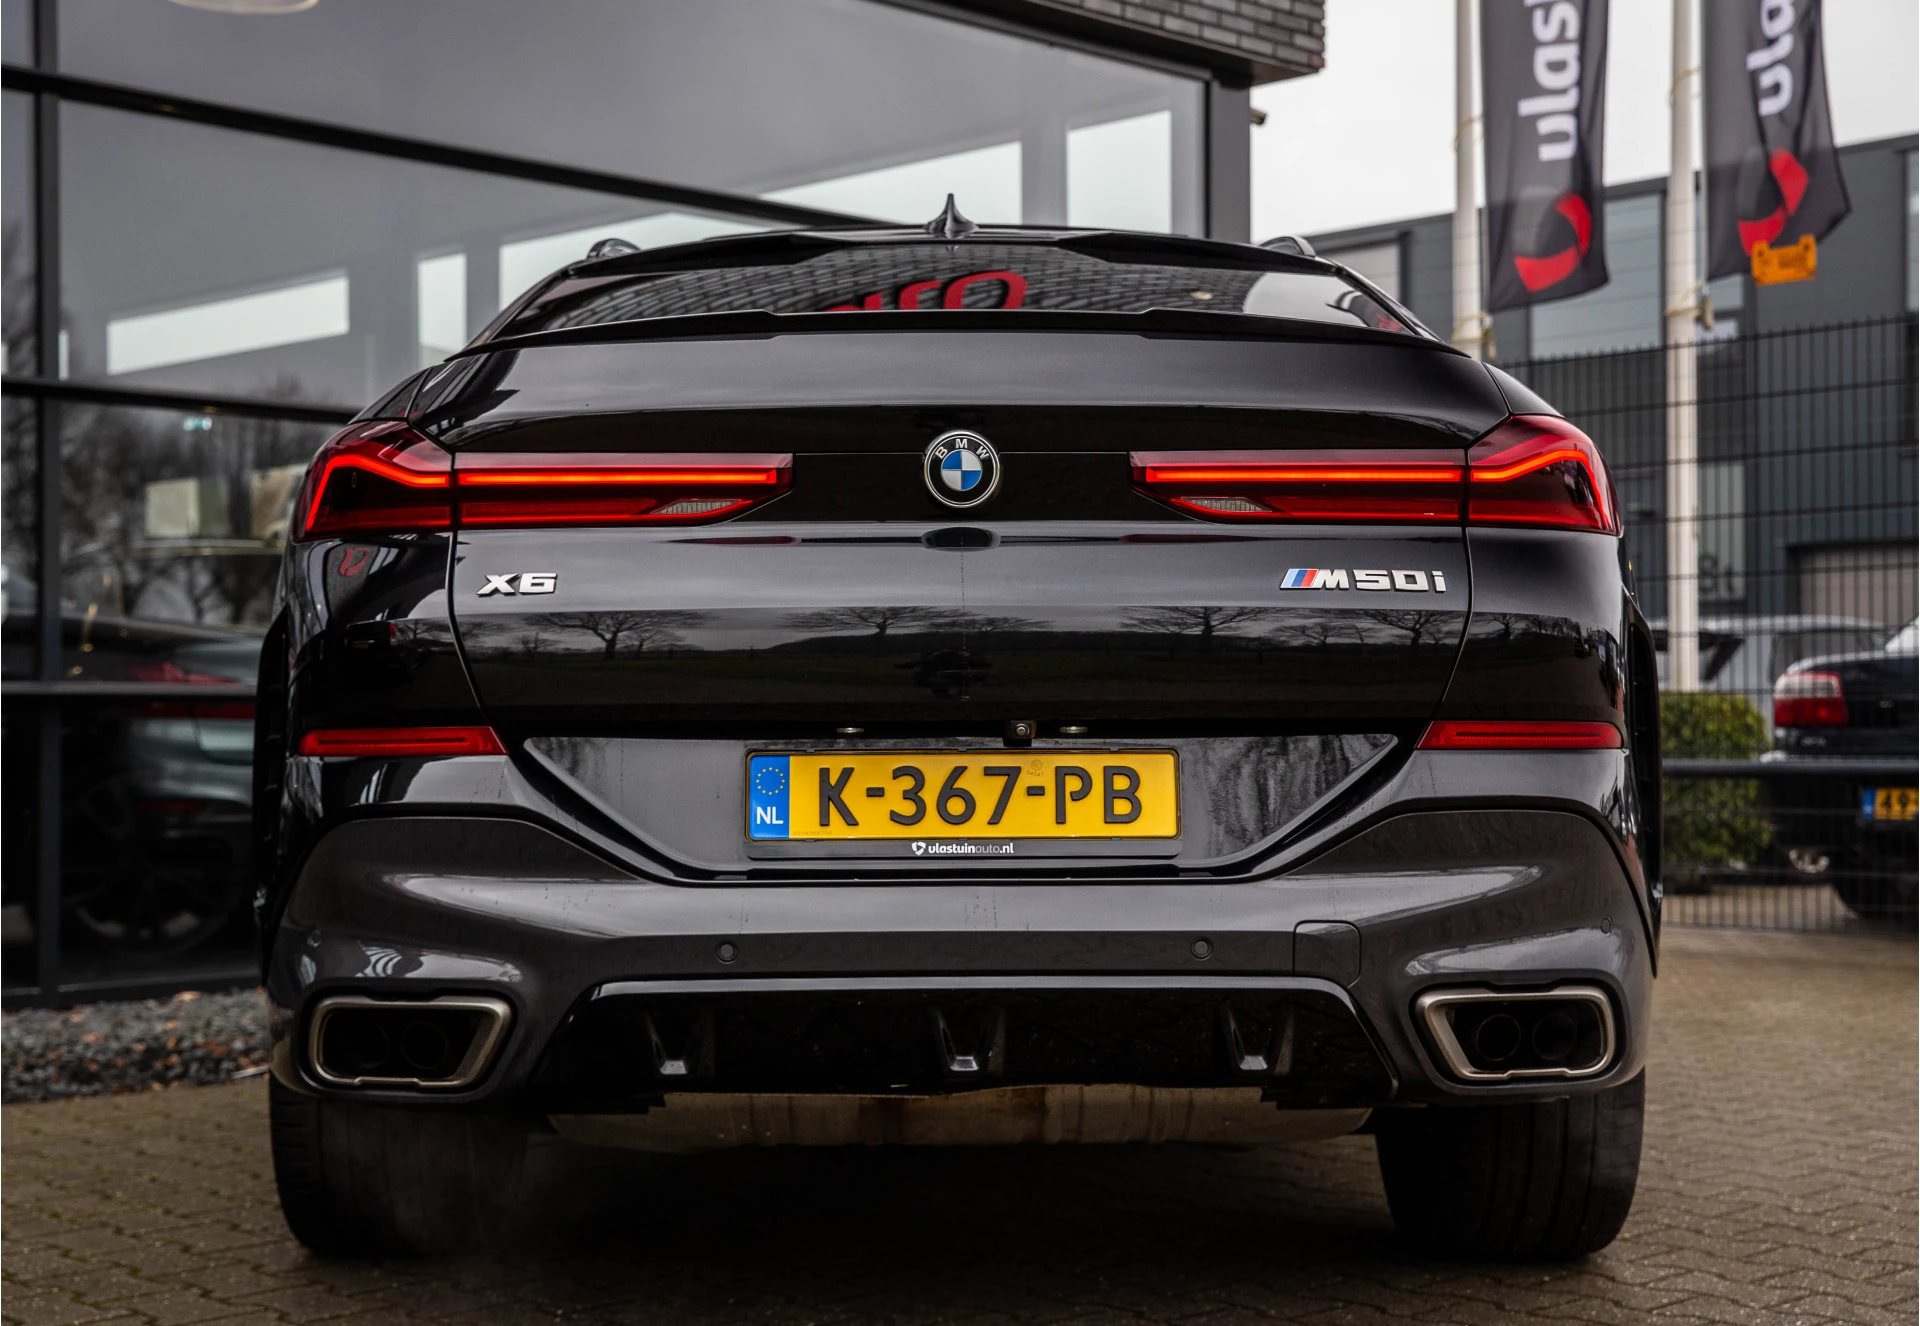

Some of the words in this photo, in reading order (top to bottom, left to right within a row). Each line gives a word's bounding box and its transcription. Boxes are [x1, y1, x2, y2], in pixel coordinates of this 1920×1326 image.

[935, 438, 990, 460] BMW
[476, 572, 558, 597] X6
[818, 765, 1143, 827] K-367-PB
[756, 806, 784, 825] NL
